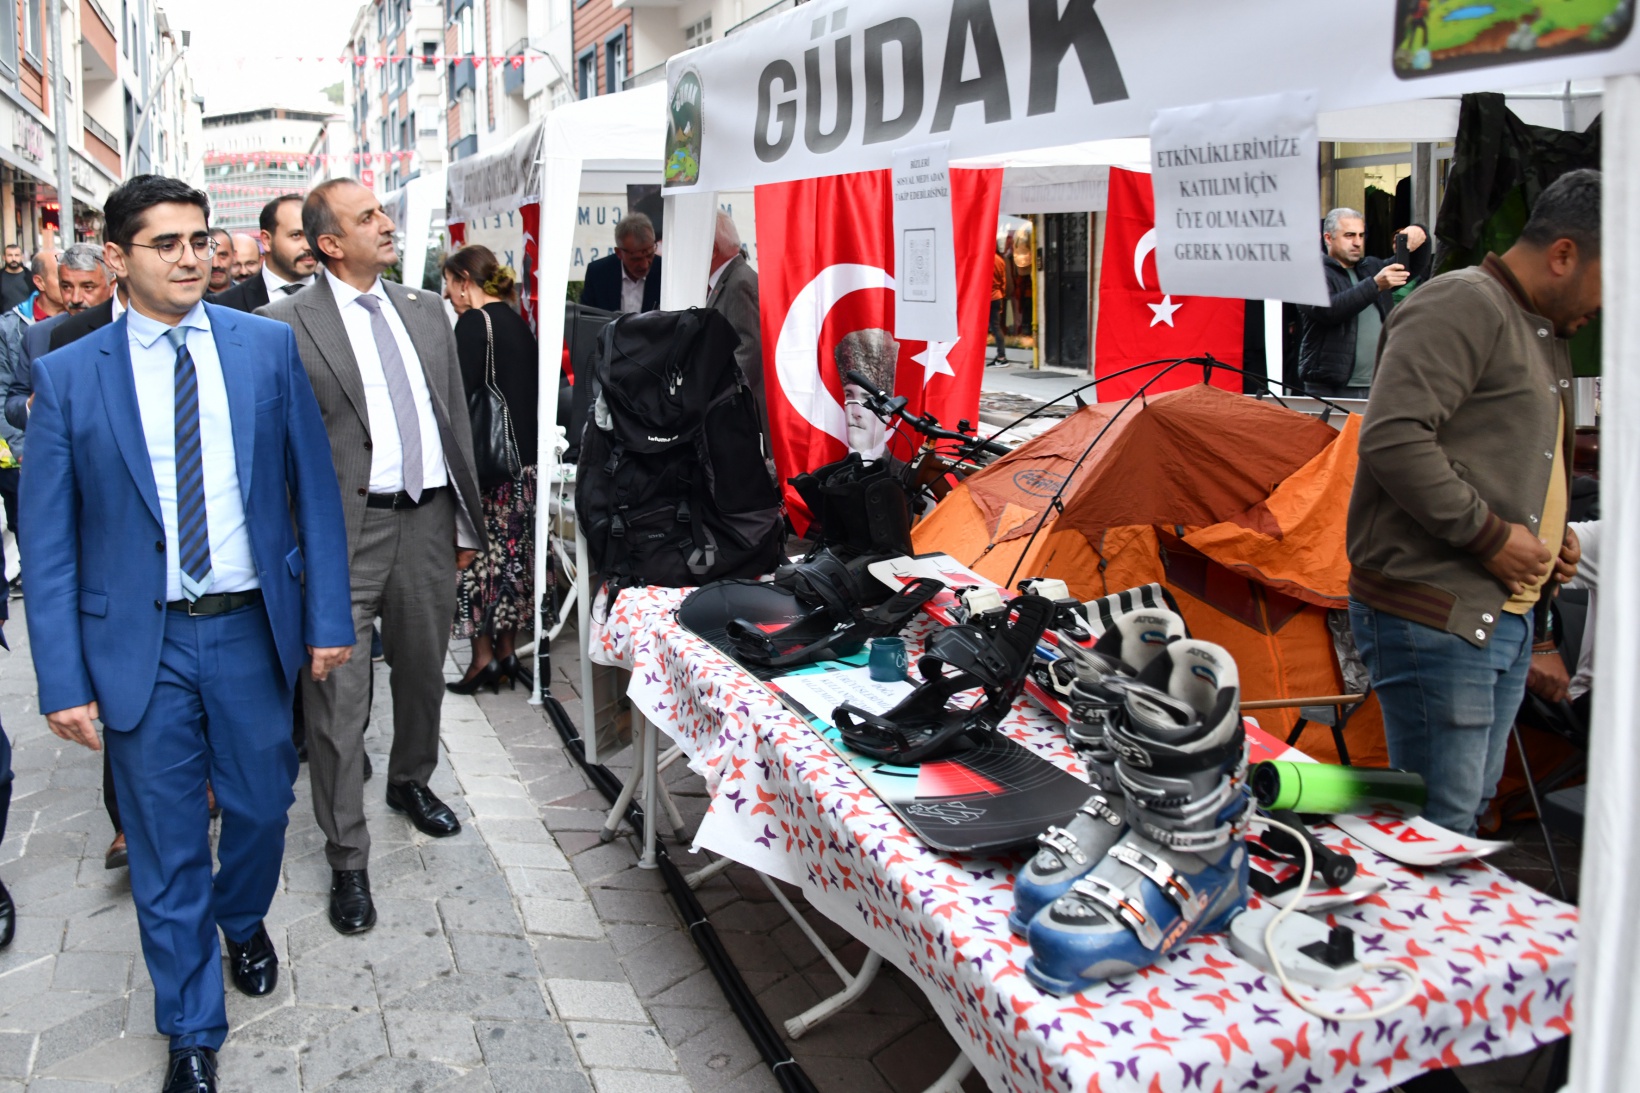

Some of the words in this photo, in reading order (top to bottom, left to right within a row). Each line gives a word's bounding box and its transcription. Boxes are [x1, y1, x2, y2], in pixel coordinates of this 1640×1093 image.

[753, 0, 1129, 163] GÜDAK
[1156, 134, 1302, 168] ETKİNLİKLERİMİZE
[910, 156, 930, 169] BİZLERİ
[896, 175, 915, 186] SOSYAL
[916, 172, 945, 184] MEDYADAN
[1178, 176, 1241, 198] KATILIM
[1244, 170, 1280, 198] İÇİN
[895, 190, 909, 202] TAKİP
[1176, 207, 1203, 229] ÜYE
[1206, 209, 1287, 229] OLMANIZA
[1174, 242, 1223, 261] GEREK
[1225, 242, 1292, 262] YOKTUR
